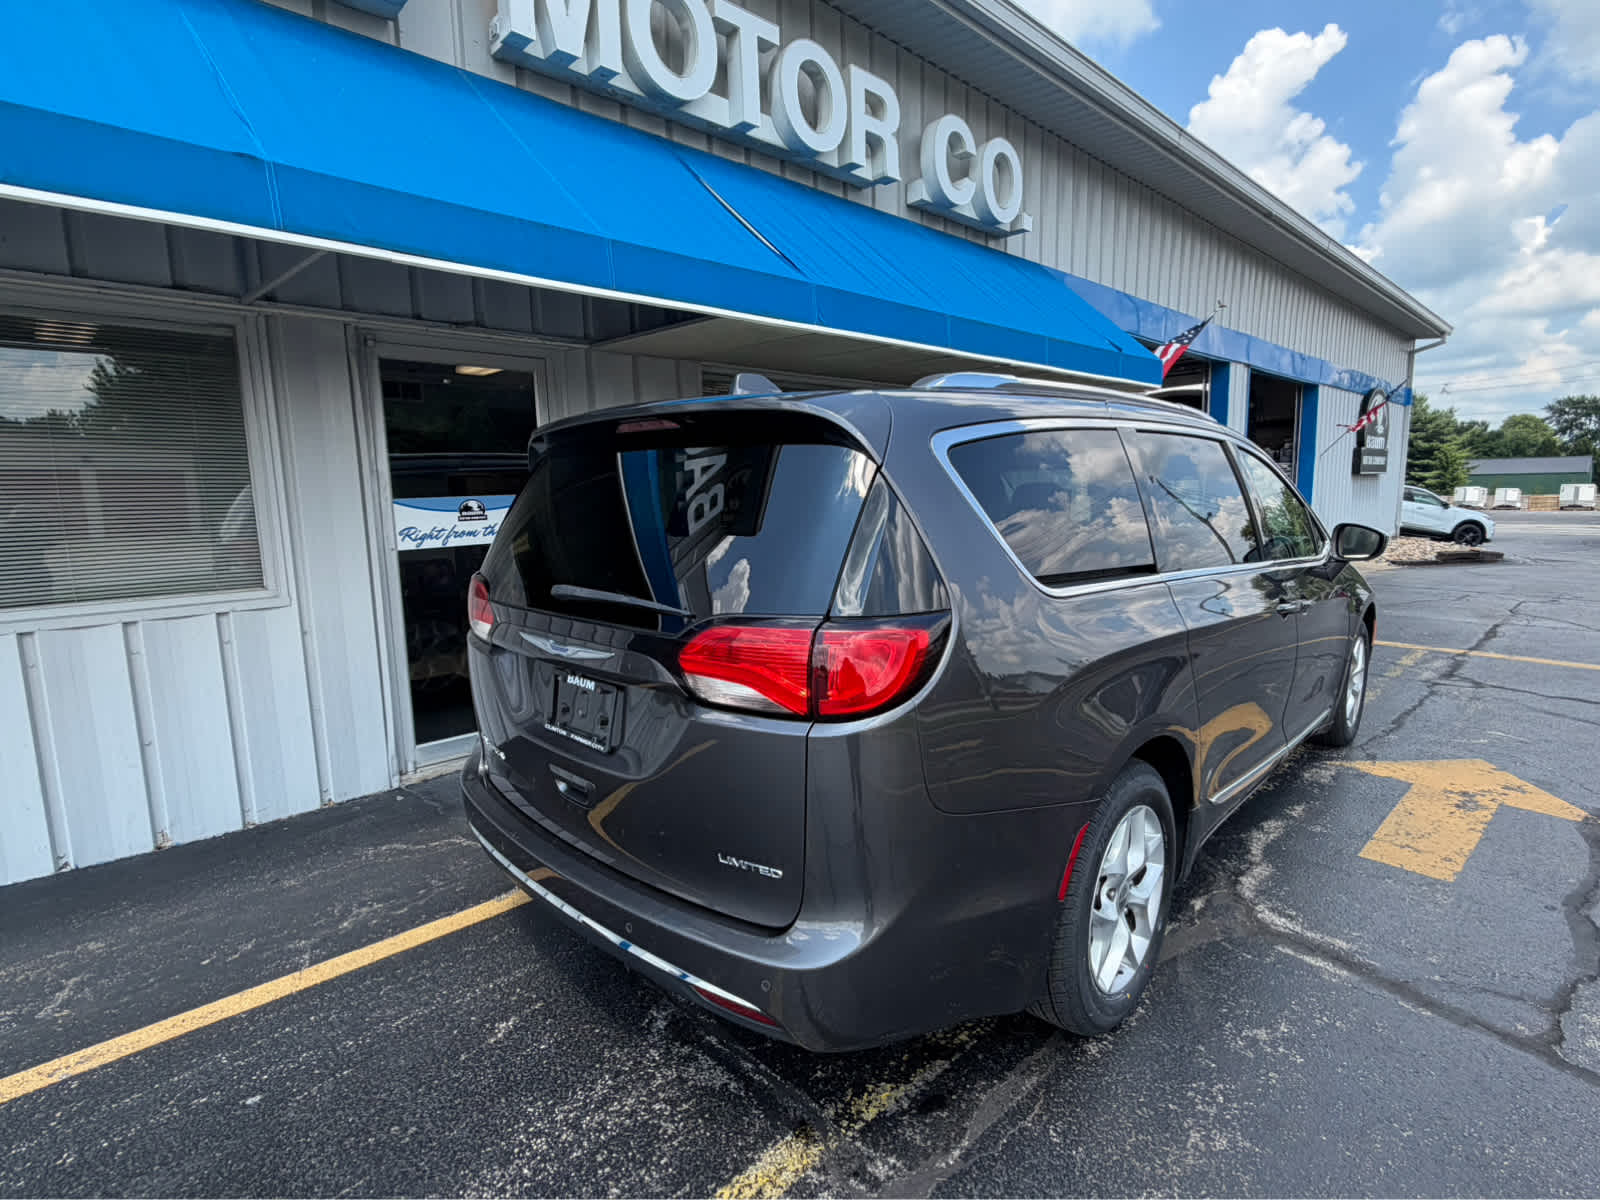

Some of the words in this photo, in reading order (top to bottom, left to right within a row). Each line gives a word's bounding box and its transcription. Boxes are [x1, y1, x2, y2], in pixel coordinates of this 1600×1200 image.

[399, 526, 445, 548] Right
[441, 524, 481, 546] from
[482, 522, 500, 536] th
[567, 674, 596, 691] BAUM
[717, 853, 783, 879] LIMITED
